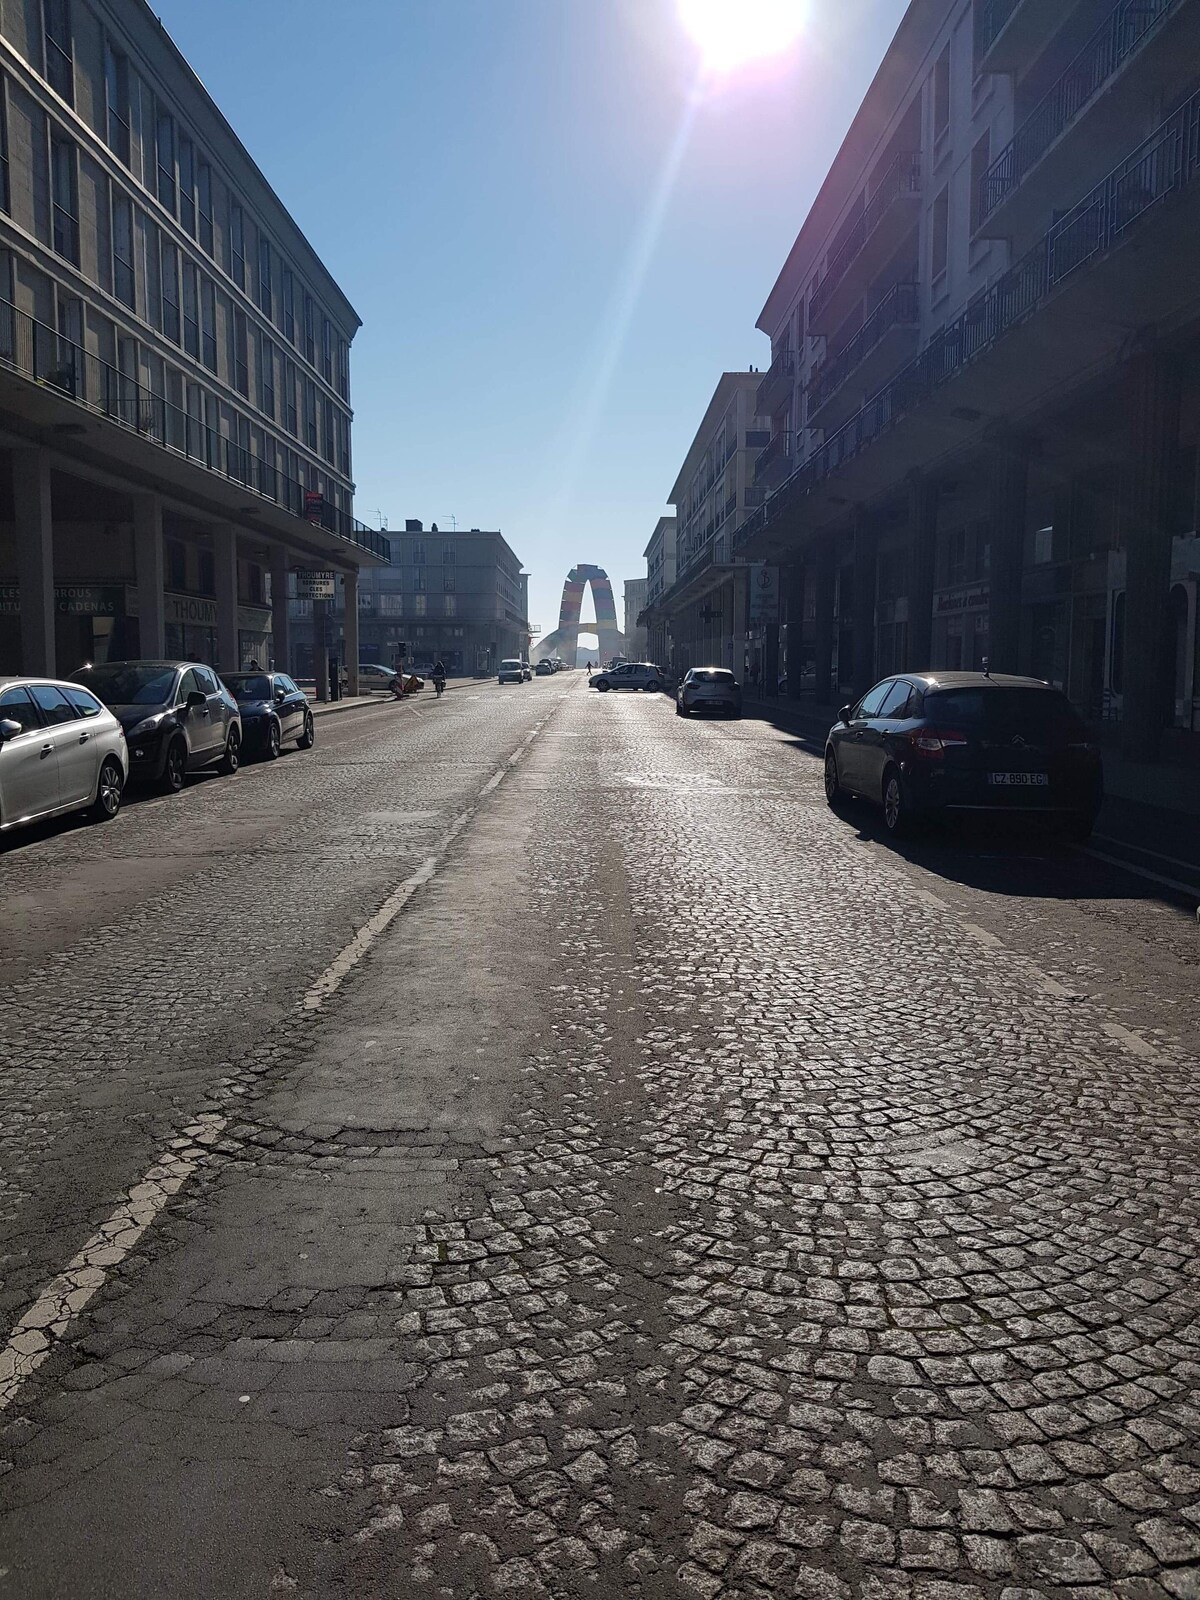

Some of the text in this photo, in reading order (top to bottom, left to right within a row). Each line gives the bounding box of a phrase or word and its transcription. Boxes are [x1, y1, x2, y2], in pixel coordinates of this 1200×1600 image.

[298, 571, 334, 579] THOUMYRE
[0, 588, 92, 598] LES RROUS
[59, 601, 114, 612] CADENAS
